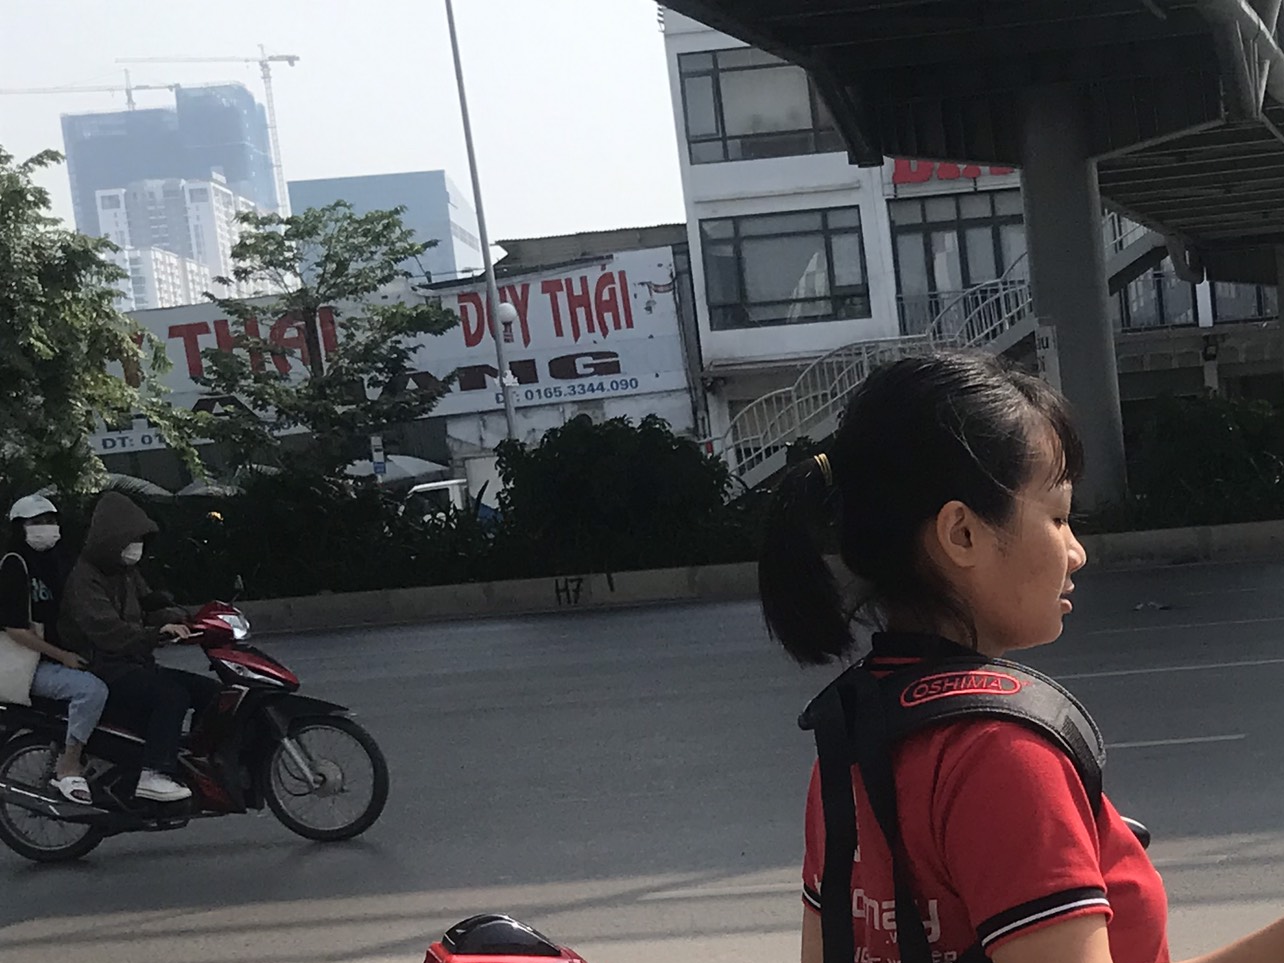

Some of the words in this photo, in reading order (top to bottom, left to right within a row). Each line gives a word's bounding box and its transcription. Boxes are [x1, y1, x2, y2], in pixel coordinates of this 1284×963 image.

[541, 262, 634, 340] THÁI
[525, 377, 639, 402] 0165.3344.090
[912, 675, 1002, 698] OSHIMA
